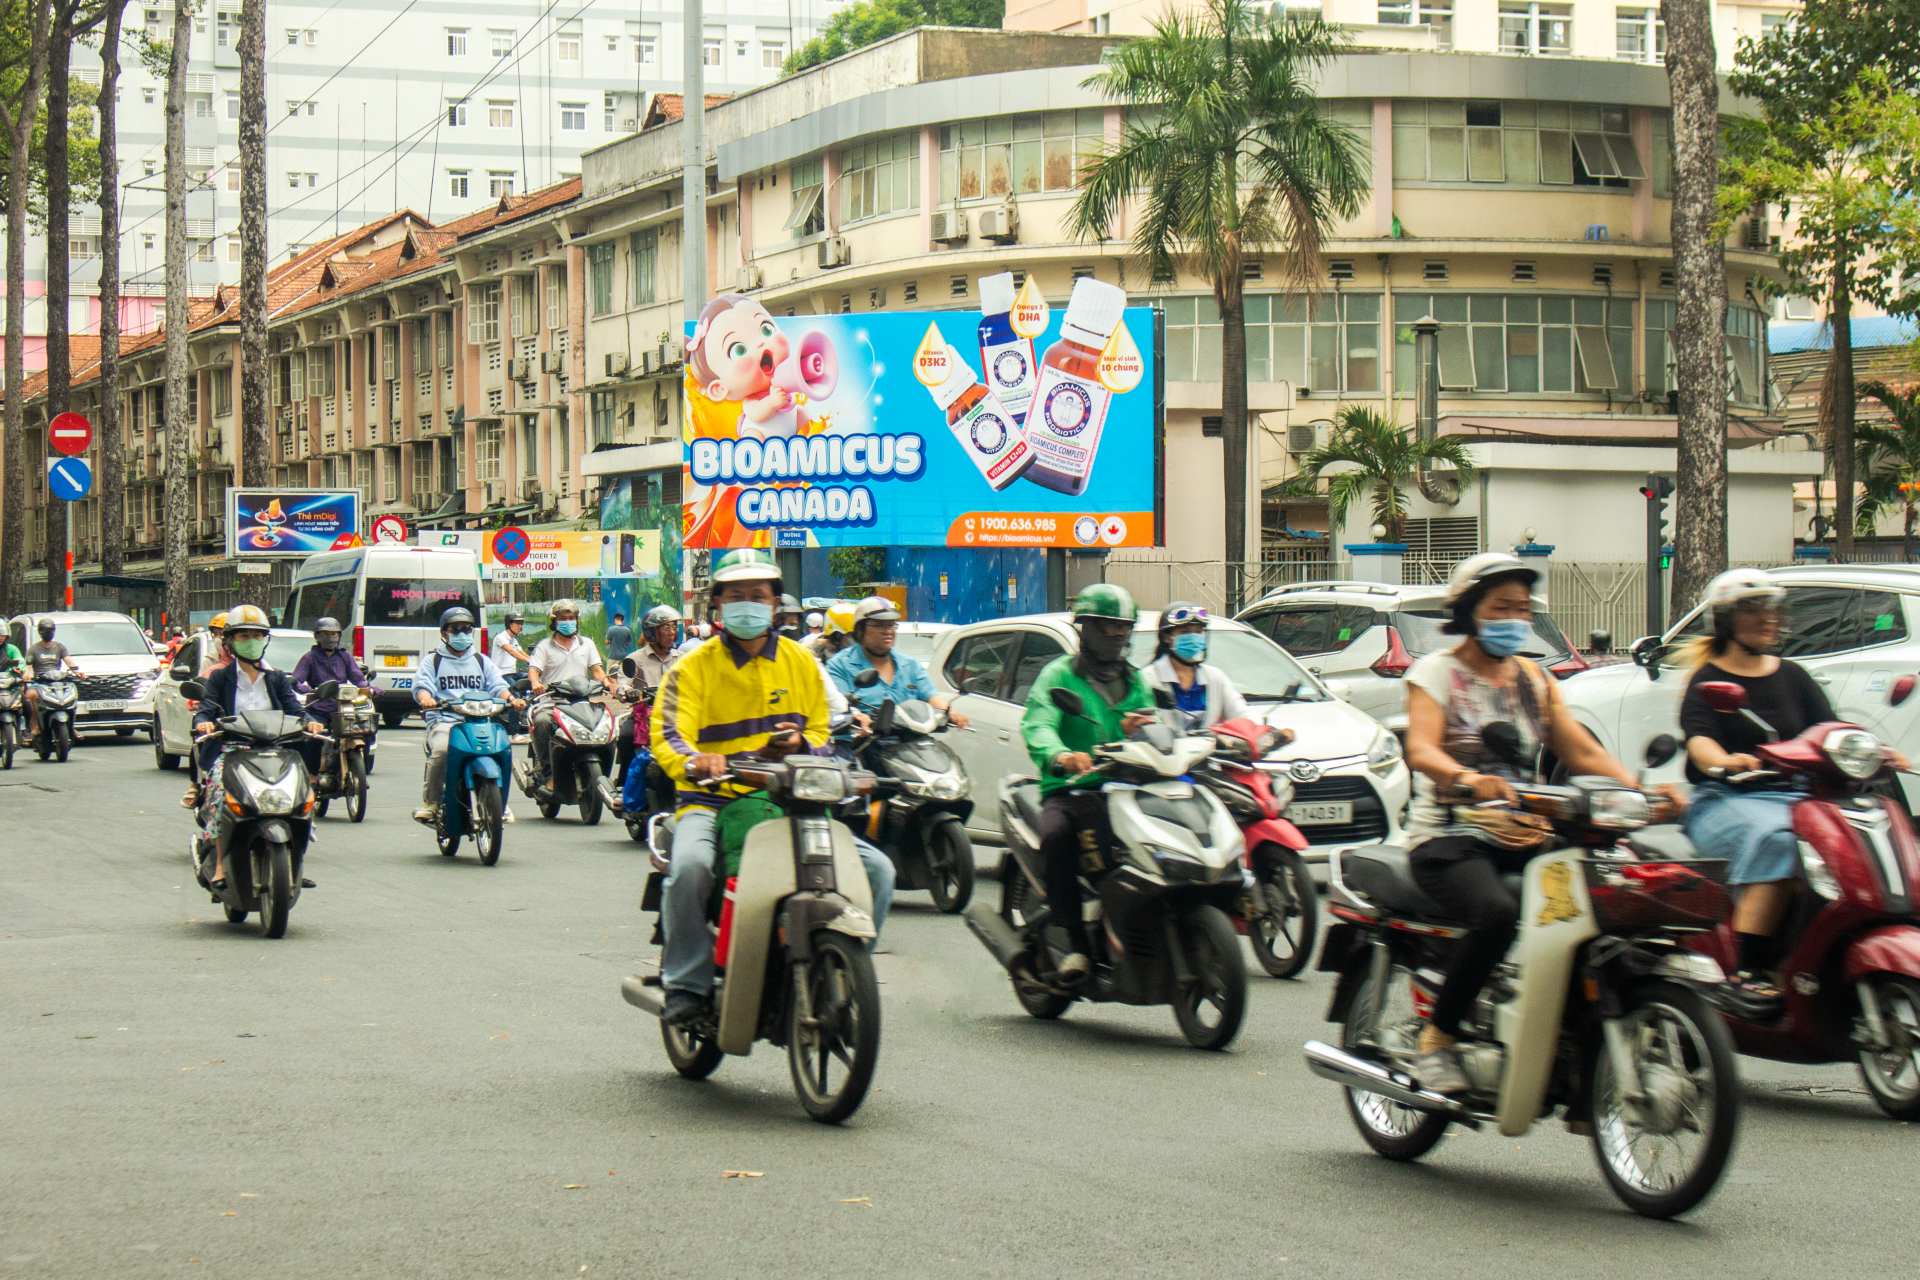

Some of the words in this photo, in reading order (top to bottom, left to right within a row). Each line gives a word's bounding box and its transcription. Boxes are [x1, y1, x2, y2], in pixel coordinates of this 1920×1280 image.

[1017, 304, 1038, 312] Omega
[1018, 312, 1041, 322] DHA
[919, 357, 946, 367] D3K2
[1101, 364, 1111, 372] 10
[1050, 383, 1091, 408] BIOAMICUS
[971, 413, 997, 439] BIOAMICUS
[1044, 411, 1086, 437] PROBIOTICS
[1029, 434, 1057, 452] BIOAMICUS
[1058, 445, 1086, 460] COMPLETE
[693, 434, 922, 479] BIOAMICUS
[989, 456, 1012, 478] VITAMIN
[1009, 444, 1025, 461] K2+D3
[739, 487, 873, 524] CANADA
[314, 512, 336, 521] mDigi
[980, 517, 1057, 531] 1900.636.985
[779, 538, 791, 546] CỐNG
[979, 533, 1056, 543] https://bioamicus.vn/
[391, 590, 424, 601] NGỌC
[424, 587, 461, 600] TUYẾT
[391, 678, 413, 689] 72B
[439, 675, 482, 690] BEINGS
[89, 701, 125, 709] 51L-060.52
